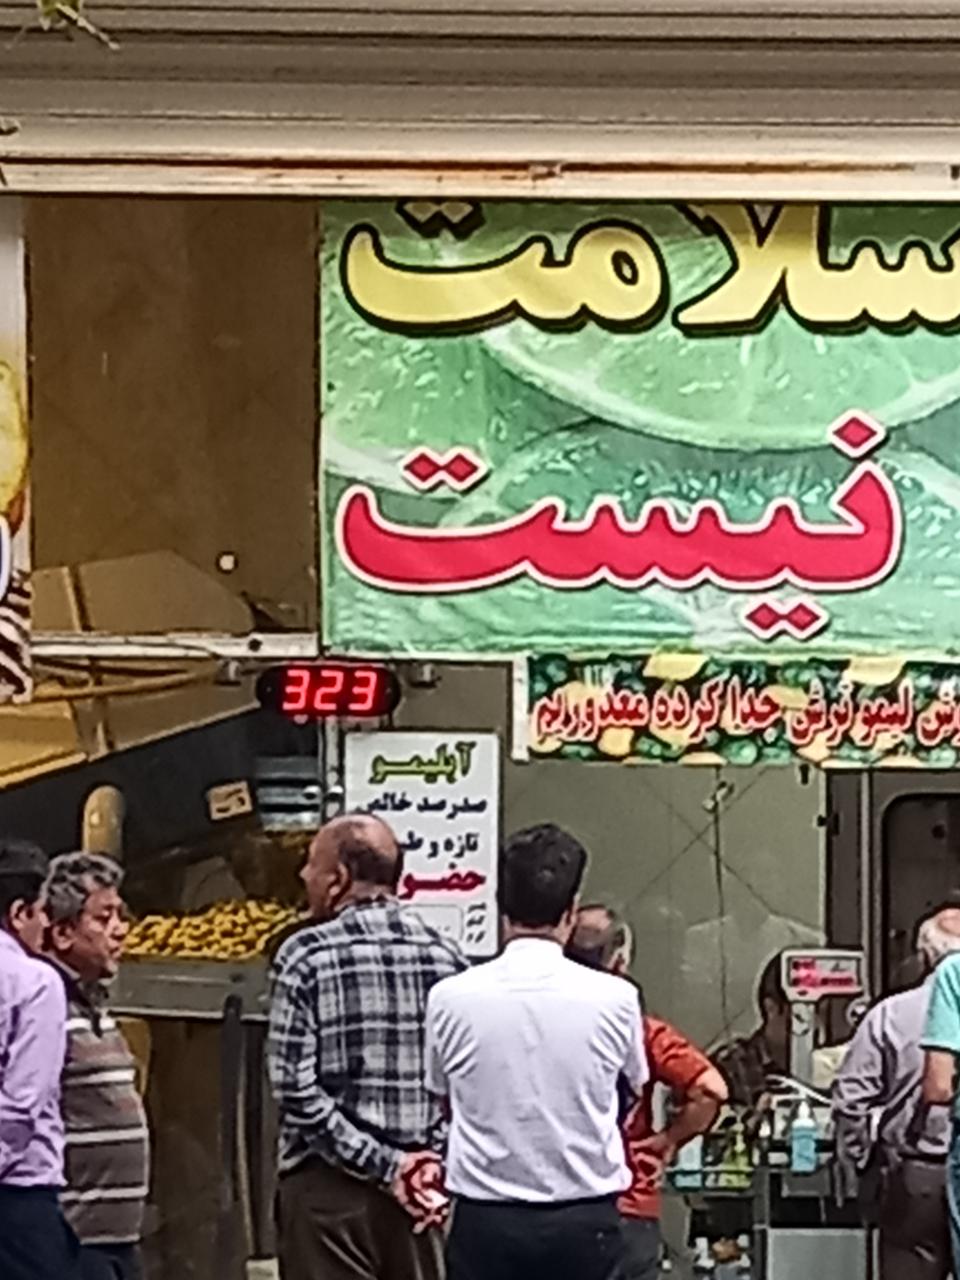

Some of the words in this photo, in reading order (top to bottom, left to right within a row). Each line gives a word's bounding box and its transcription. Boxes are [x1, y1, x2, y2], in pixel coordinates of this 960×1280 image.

[333, 409, 904, 640] نیست
[283, 669, 378, 711] 323
[651, 670, 730, 744] کرده
[728, 675, 782, 744] جدا
[368, 741, 477, 785] آبلیمو
[443, 832, 480, 859] تازه
